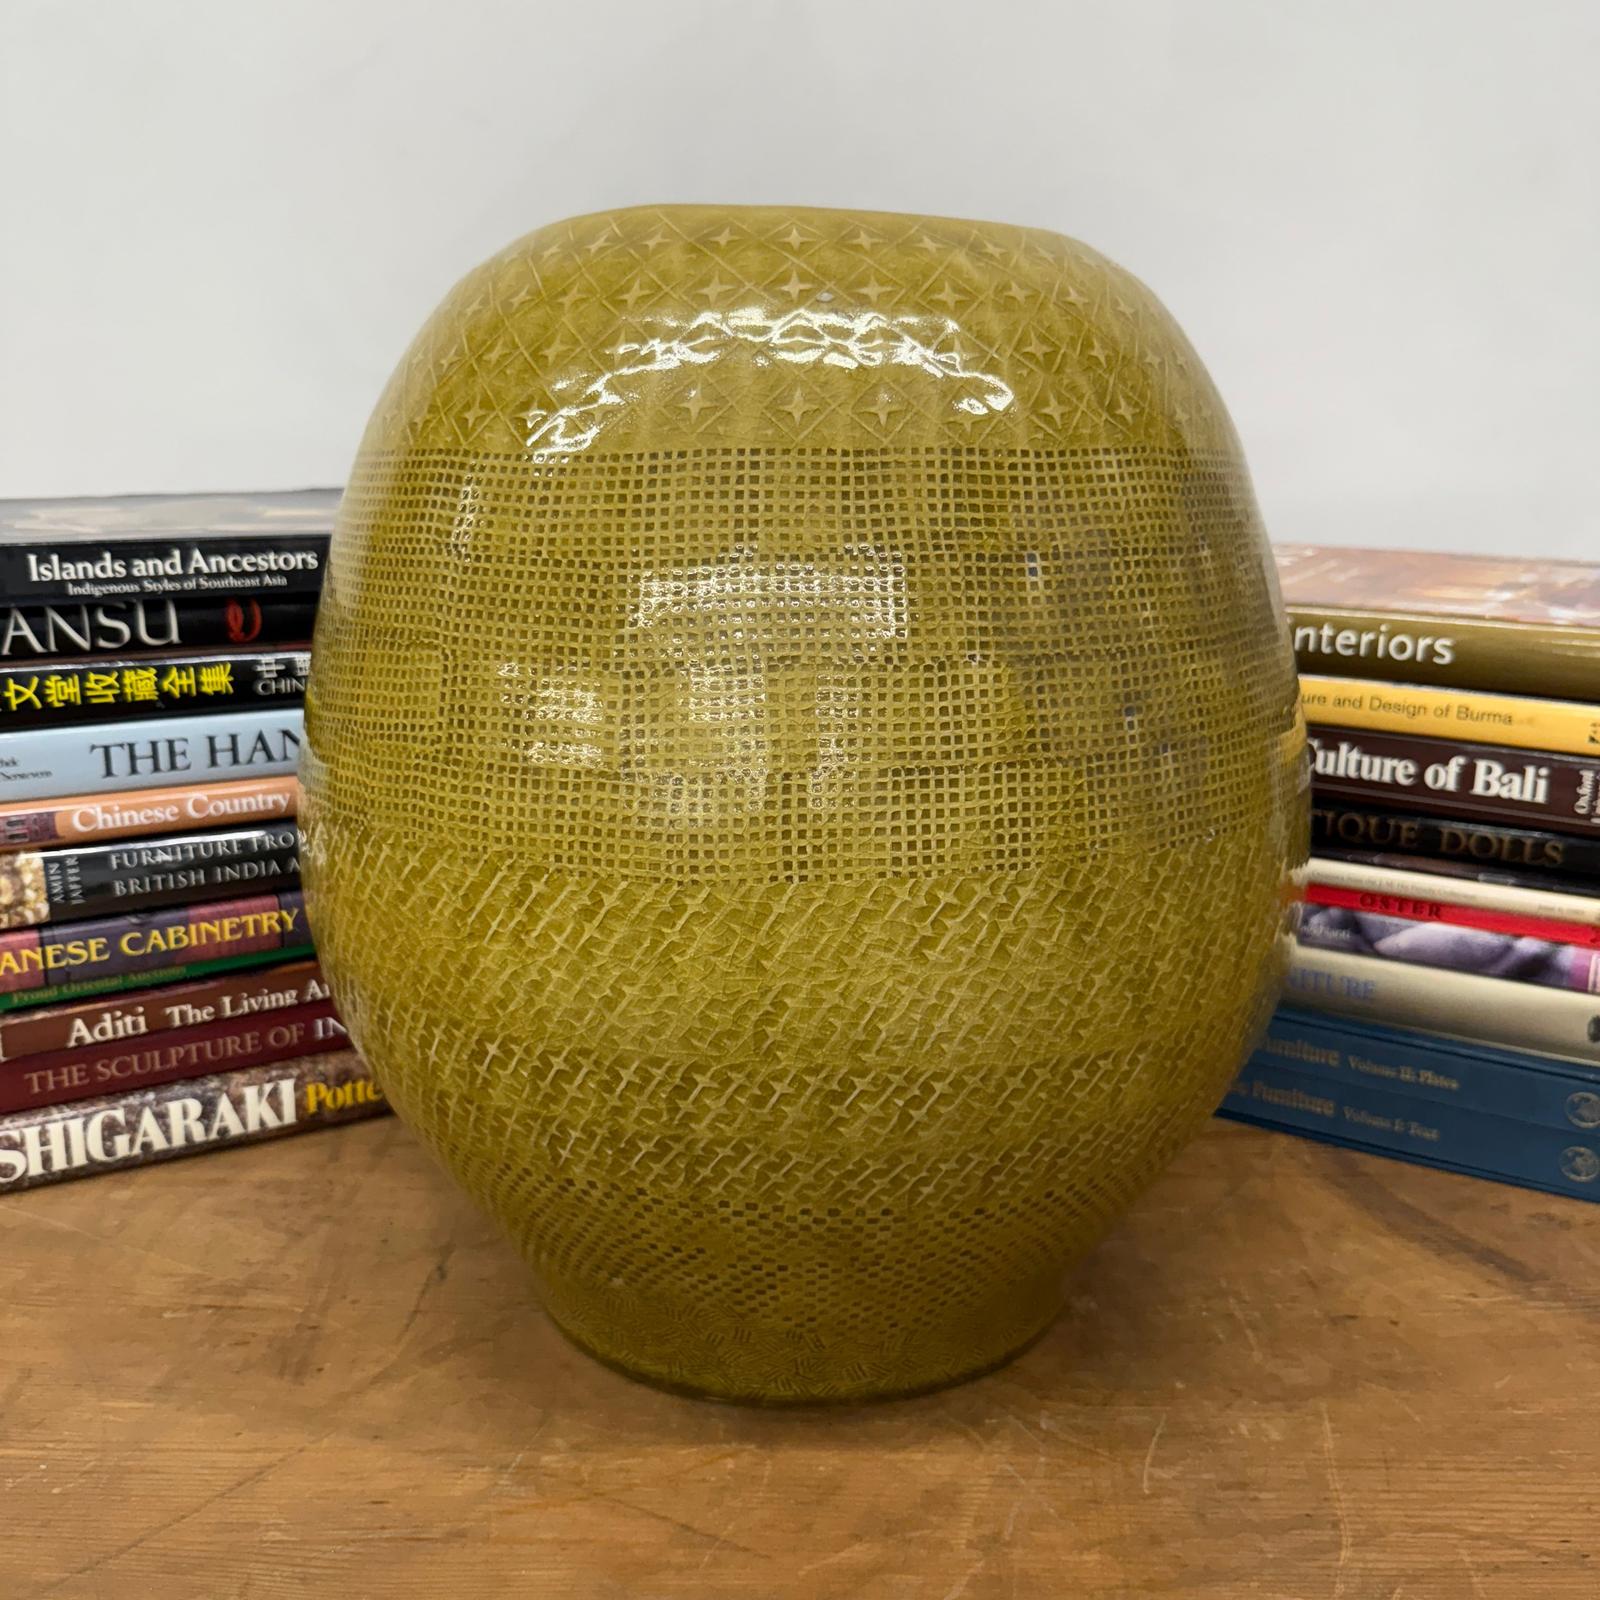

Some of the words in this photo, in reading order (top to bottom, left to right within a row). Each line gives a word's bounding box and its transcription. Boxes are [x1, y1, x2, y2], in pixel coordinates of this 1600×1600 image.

[27, 553, 126, 581] Islands
[132, 550, 183, 575] and
[190, 548, 319, 573] Ancestors
[67, 578, 140, 597] Indigenous
[144, 577, 181, 595] Styles
[184, 577, 198, 590] of
[199, 575, 260, 591] Southeast
[263, 574, 288, 587] Asia
[0, 600, 182, 655] ANSU
[1285, 617, 1455, 665] nteriors
[1332, 696, 1362, 710] and
[1369, 697, 1428, 719] Design
[1434, 705, 1451, 719] of
[1456, 706, 1513, 726] Burma
[91, 737, 191, 778] THE
[1424, 756, 1468, 792] of
[1470, 758, 1550, 804] Bali
[72, 805, 179, 833] Chinese
[187, 791, 291, 820] Country
[110, 840, 242, 871] FURNITURE
[1440, 826, 1565, 866] DOLLS
[113, 868, 206, 897] BRITISH
[215, 859, 283, 884] INDIA
[0, 934, 110, 977] ANESE
[120, 908, 299, 957] CABINETRY
[66, 1006, 149, 1048] Aditi
[163, 1003, 216, 1028] The
[221, 988, 298, 1018] Living
[24, 1065, 91, 1095] THE
[97, 1031, 261, 1081] SCULPTURE
[268, 1022, 306, 1047] OF
[1347, 1054, 1397, 1078] Volume
[0, 1079, 297, 1183] SHIGARAKI
[1343, 1105, 1392, 1129] Volume
